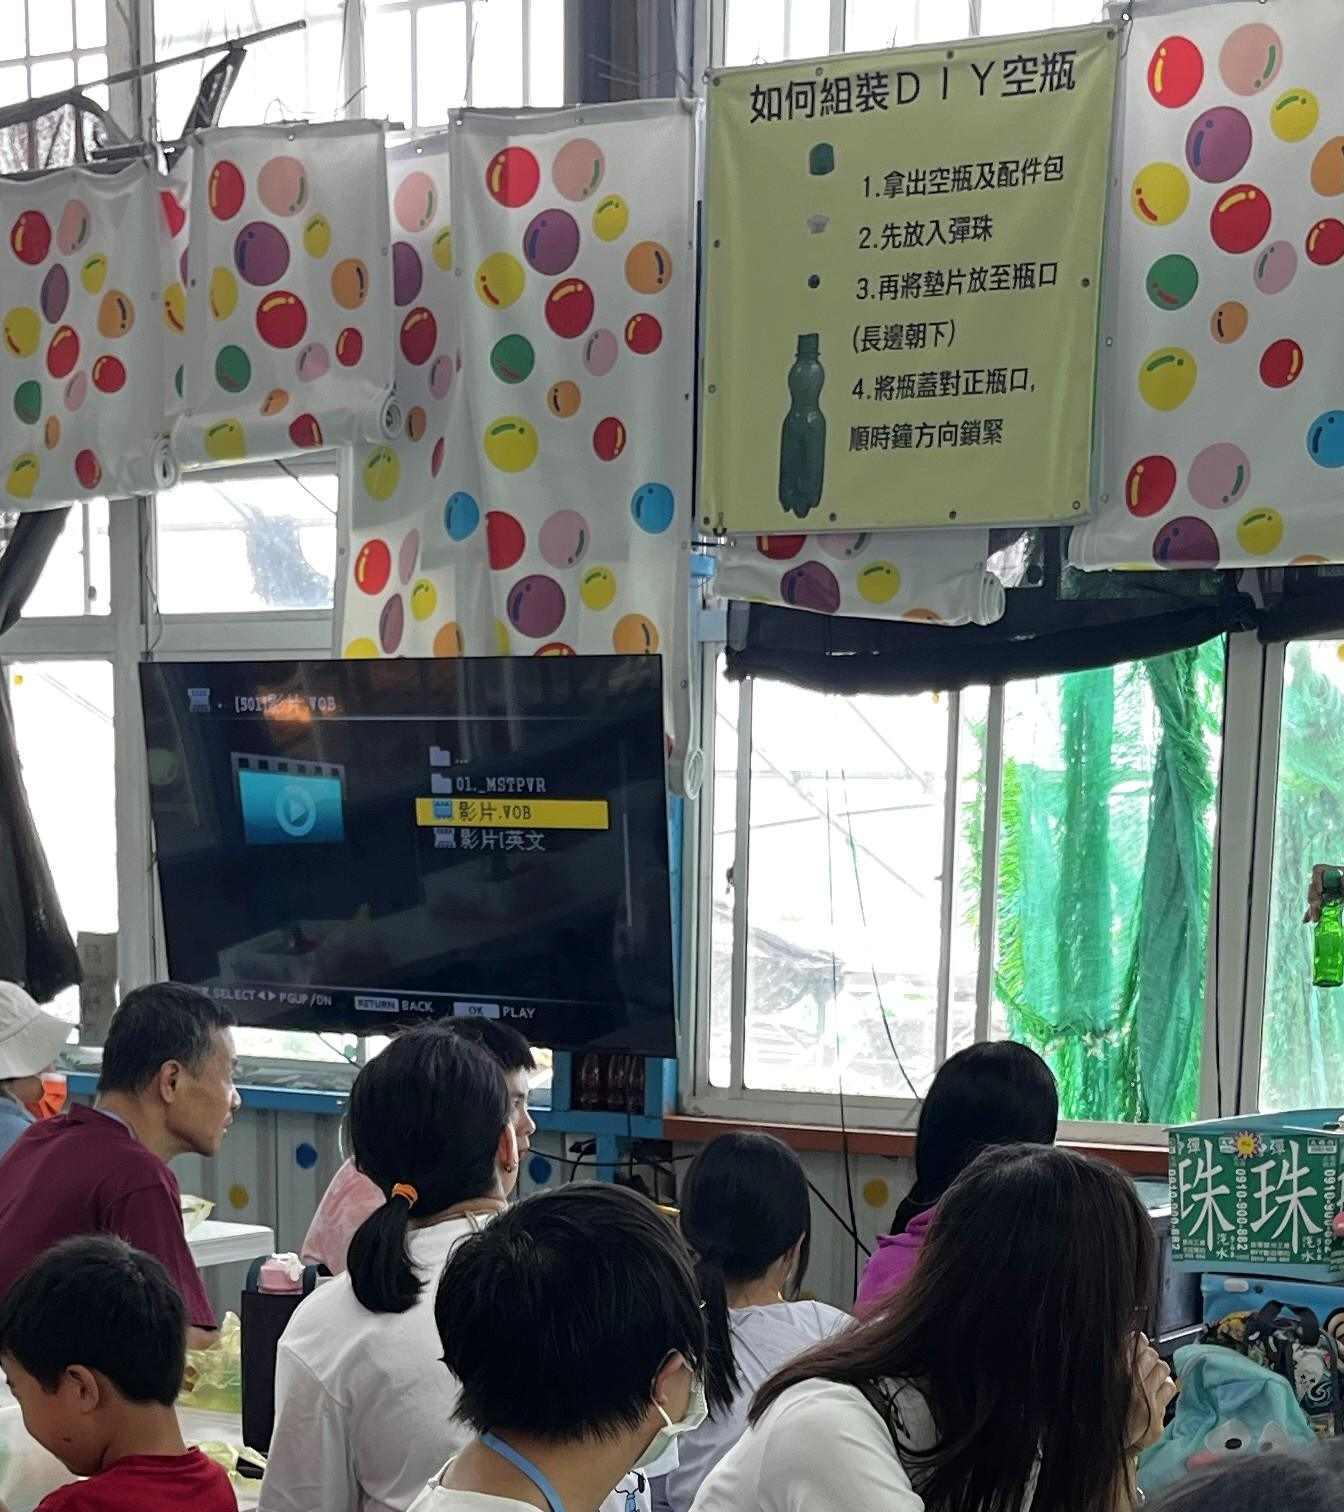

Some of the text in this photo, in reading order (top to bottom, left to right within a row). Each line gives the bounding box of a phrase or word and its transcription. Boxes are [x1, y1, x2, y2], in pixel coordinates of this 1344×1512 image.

[863, 155, 1064, 199] 1.拿出空瓶及配件包
[858, 214, 993, 251] 2.先放入彈珠
[855, 262, 1058, 301] 3.再將墊片放至瓶口
[849, 418, 1004, 452] 順時鐘方向鎖緊
[401, 1000, 433, 1013] BACK
[502, 1005, 536, 1019] PLAY
[1250, 1139, 1324, 1255] 珠
